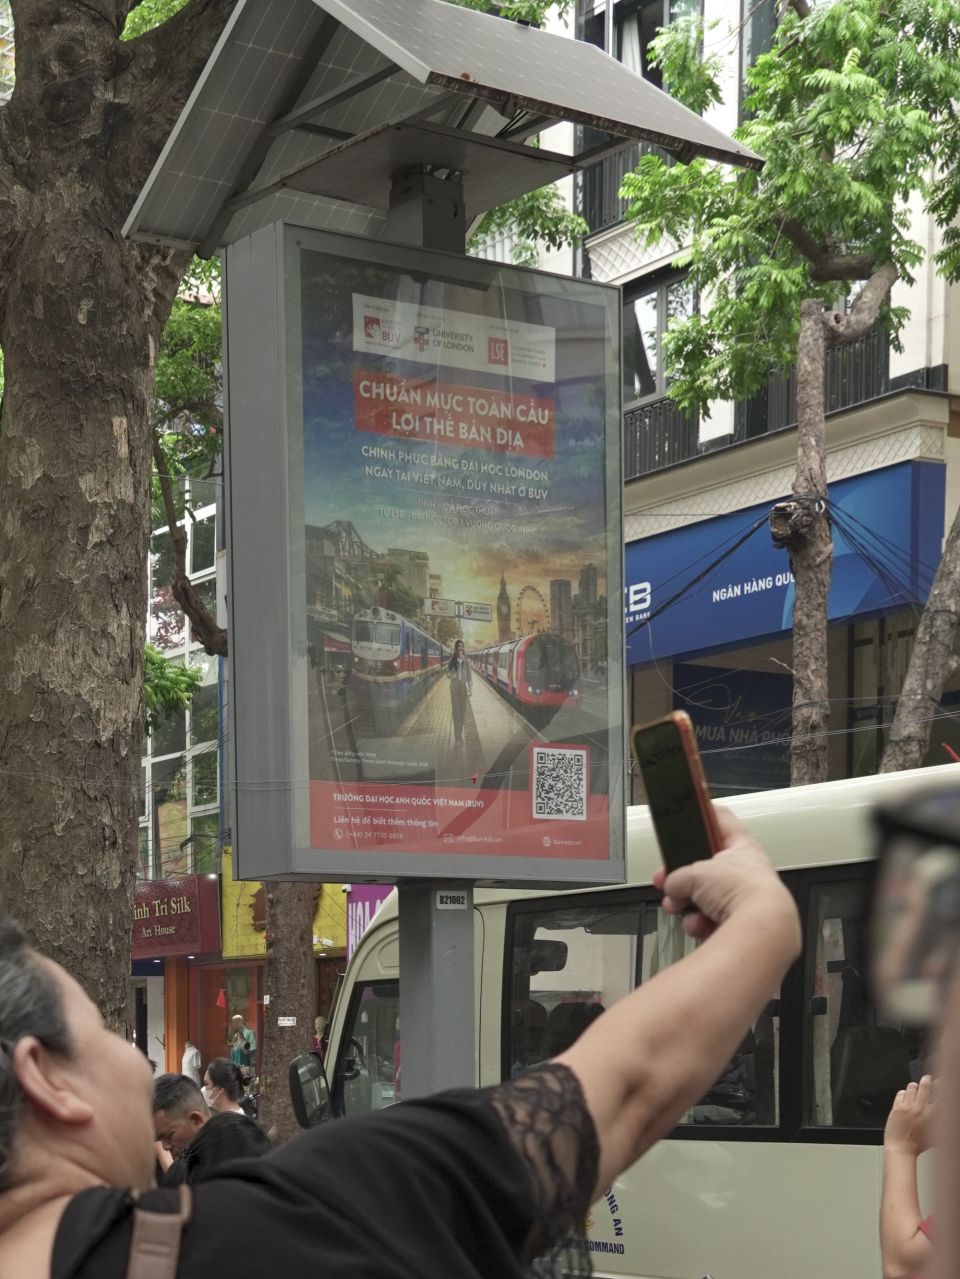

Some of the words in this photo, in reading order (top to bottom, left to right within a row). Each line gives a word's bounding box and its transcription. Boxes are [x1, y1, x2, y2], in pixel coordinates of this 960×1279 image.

[381, 330, 401, 343] BUV
[432, 328, 474, 342] UNIVERSITY
[432, 339, 442, 349] OF
[443, 340, 475, 353] LONDON
[490, 343, 506, 361] LSE
[359, 378, 422, 405] CHUẨN
[426, 391, 465, 415] MỰC
[467, 396, 512, 419] TOÀN
[516, 400, 549, 425] CẦU
[392, 411, 420, 435] LỢI
[424, 413, 455, 437] THẾ
[459, 420, 492, 443] BẢN
[496, 429, 525, 450] ĐỊA
[505, 463, 548, 481] LONDON
[365, 465, 394, 480] NGAY
[528, 488, 549, 500] BUV
[712, 584, 741, 603] NGÂN
[743, 577, 773, 595] HÀNG
[153, 898, 168, 917] Trí
[170, 896, 192, 915] Silk
[154, 925, 176, 936] House
